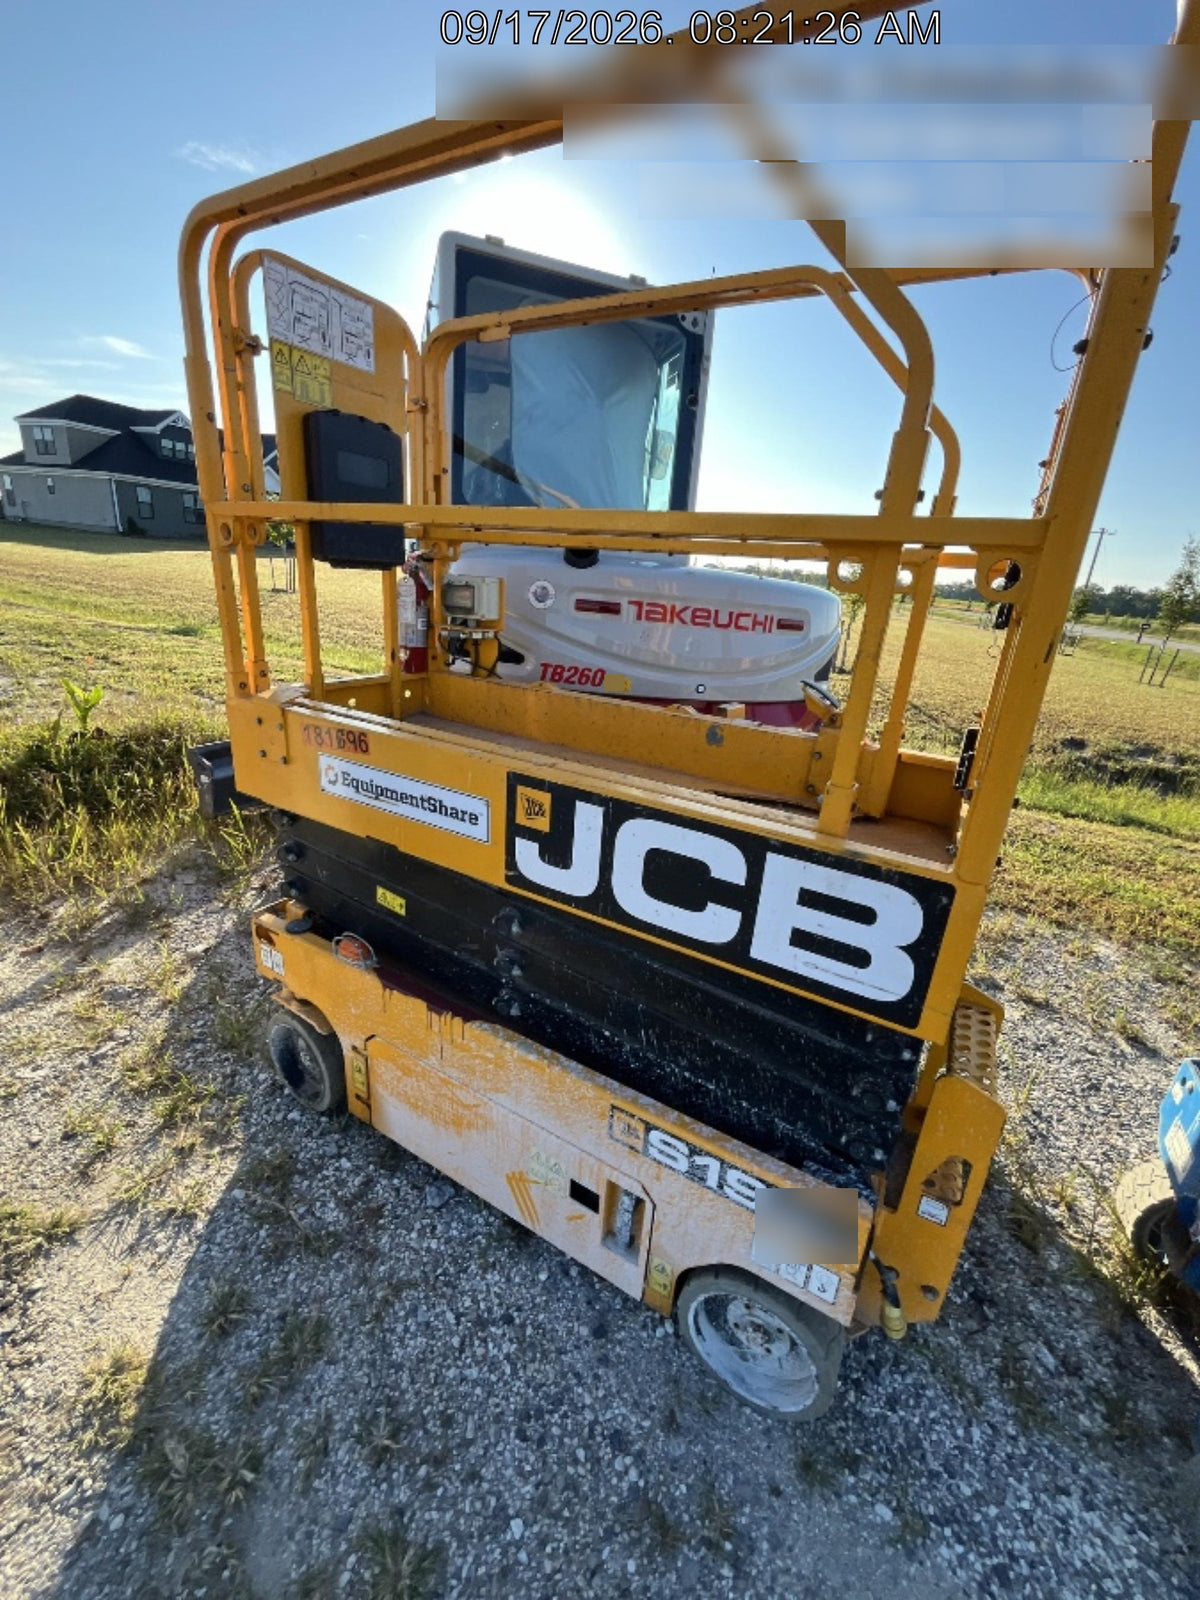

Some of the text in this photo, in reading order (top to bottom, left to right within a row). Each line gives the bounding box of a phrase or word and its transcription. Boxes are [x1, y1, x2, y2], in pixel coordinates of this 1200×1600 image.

[539, 662, 605, 688] TB260
[341, 770, 480, 827] EquipmentShare
[514, 800, 924, 1002] JCB
